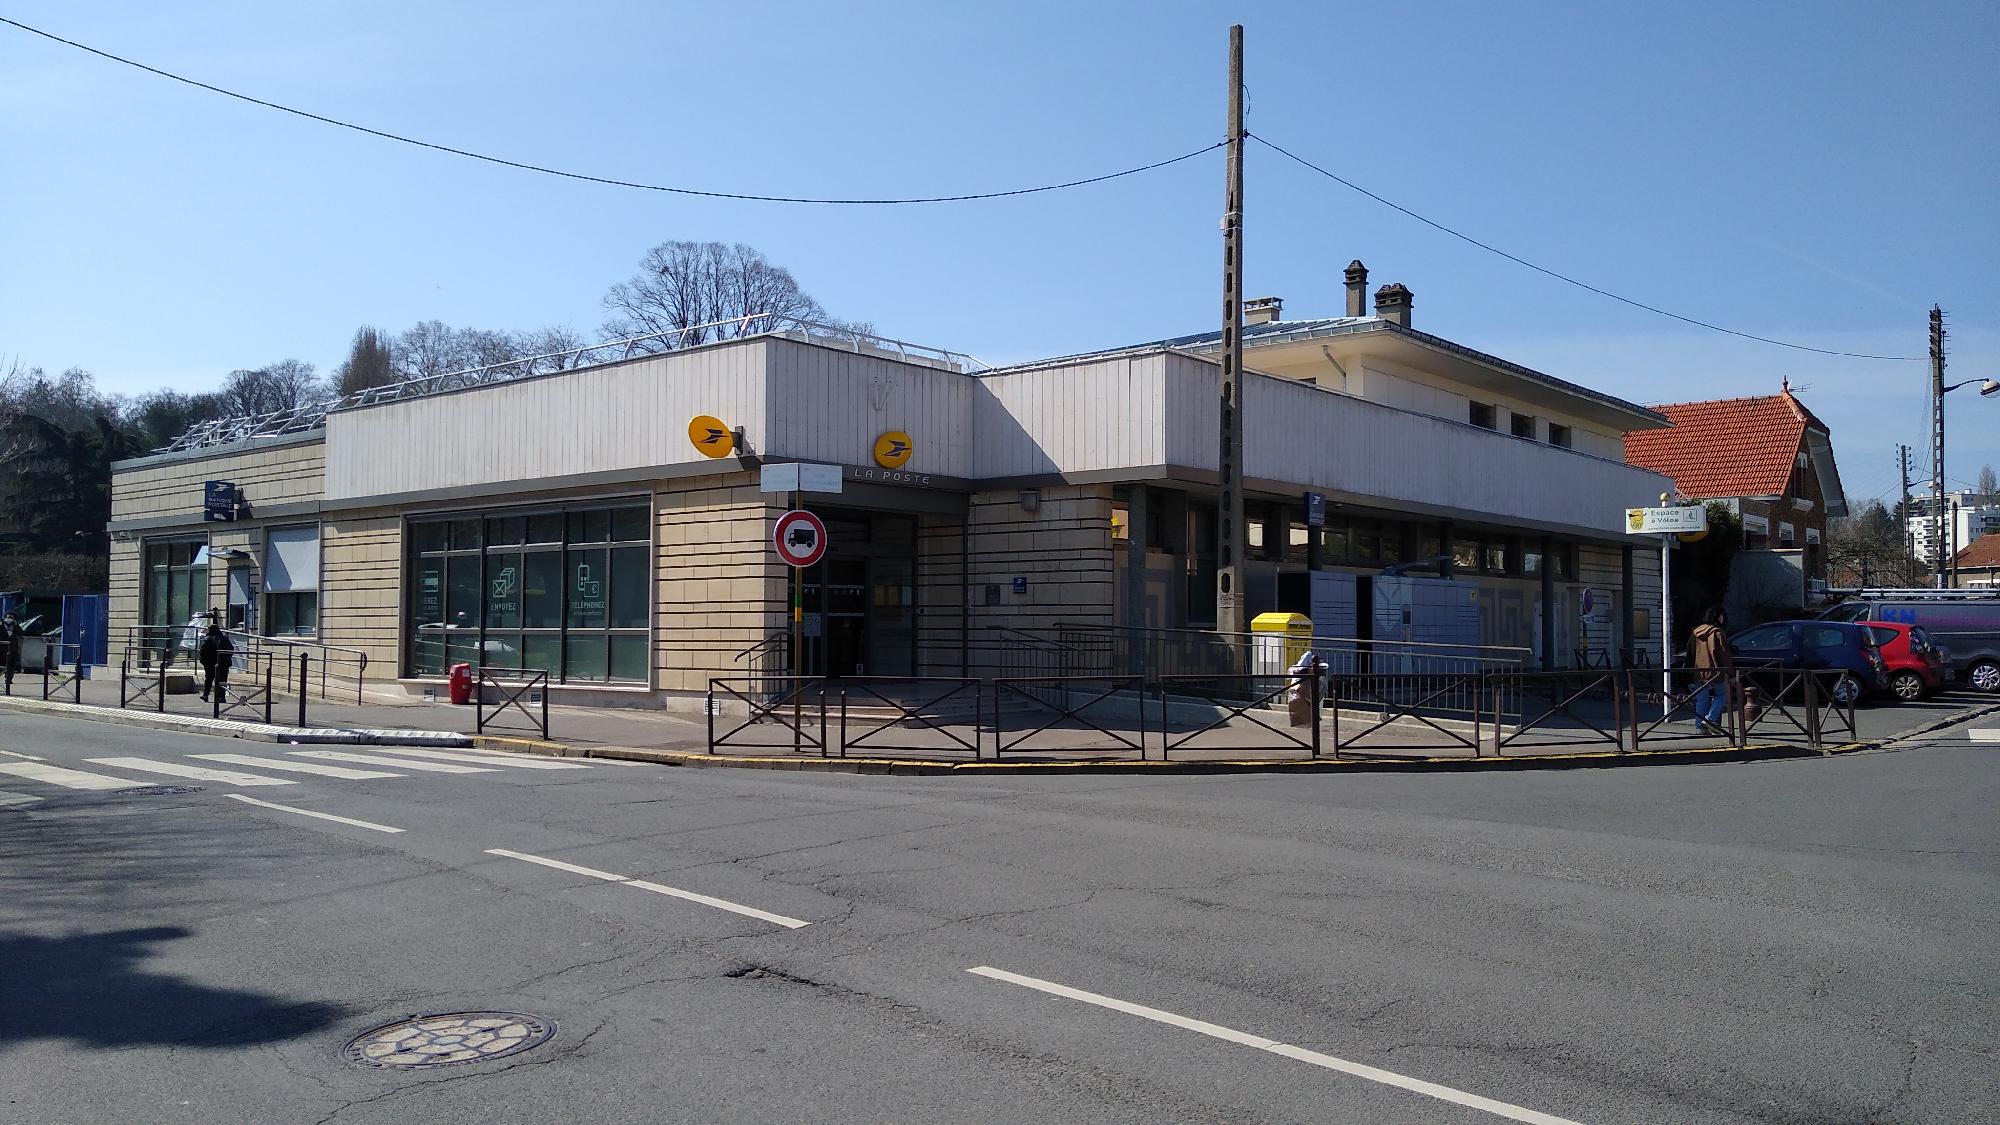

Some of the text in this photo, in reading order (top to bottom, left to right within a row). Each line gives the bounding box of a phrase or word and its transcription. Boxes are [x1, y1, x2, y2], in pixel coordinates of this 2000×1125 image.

[854, 468, 931, 485] LA POSTE
[1650, 509, 1680, 517] Espace
